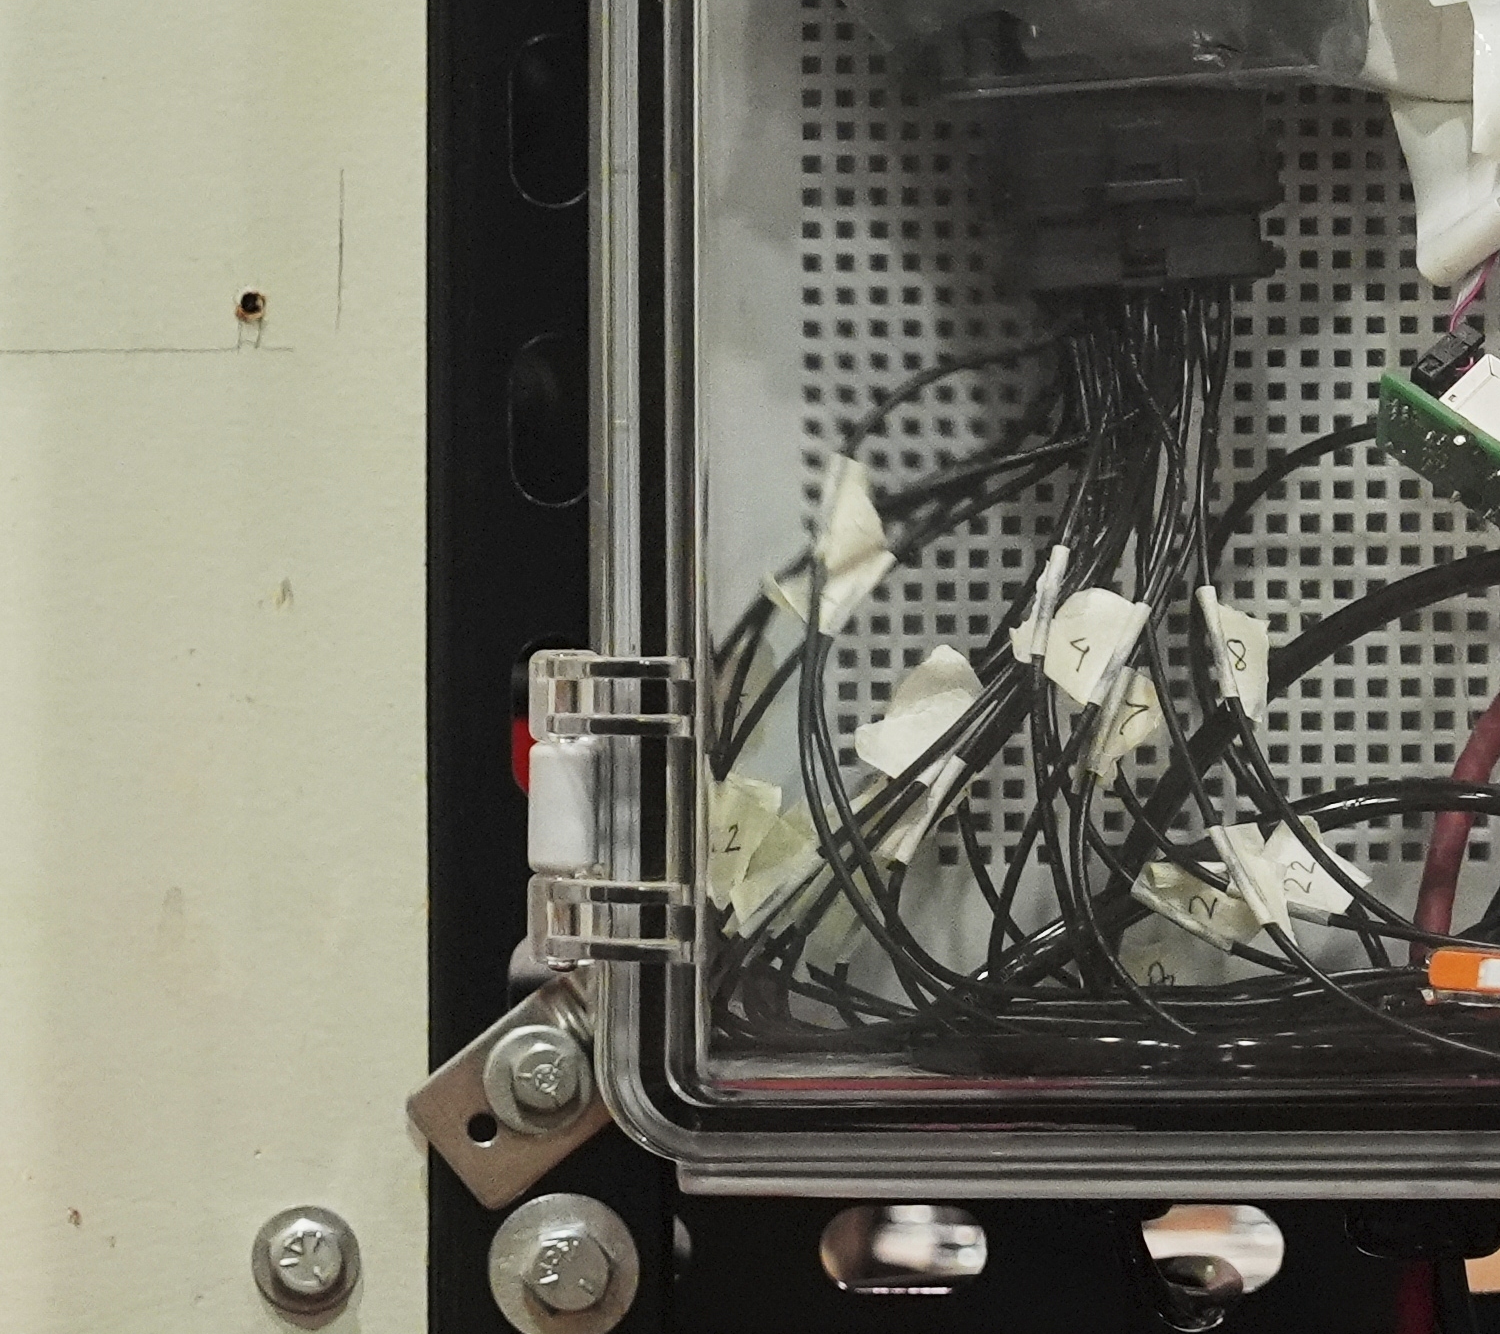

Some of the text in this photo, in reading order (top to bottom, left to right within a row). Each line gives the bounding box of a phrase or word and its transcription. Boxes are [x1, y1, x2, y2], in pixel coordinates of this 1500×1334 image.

[1069, 637, 1091, 672] 4
[1227, 639, 1248, 671] 8
[1284, 860, 1317, 894] 22
[1189, 895, 1218, 919] 2
